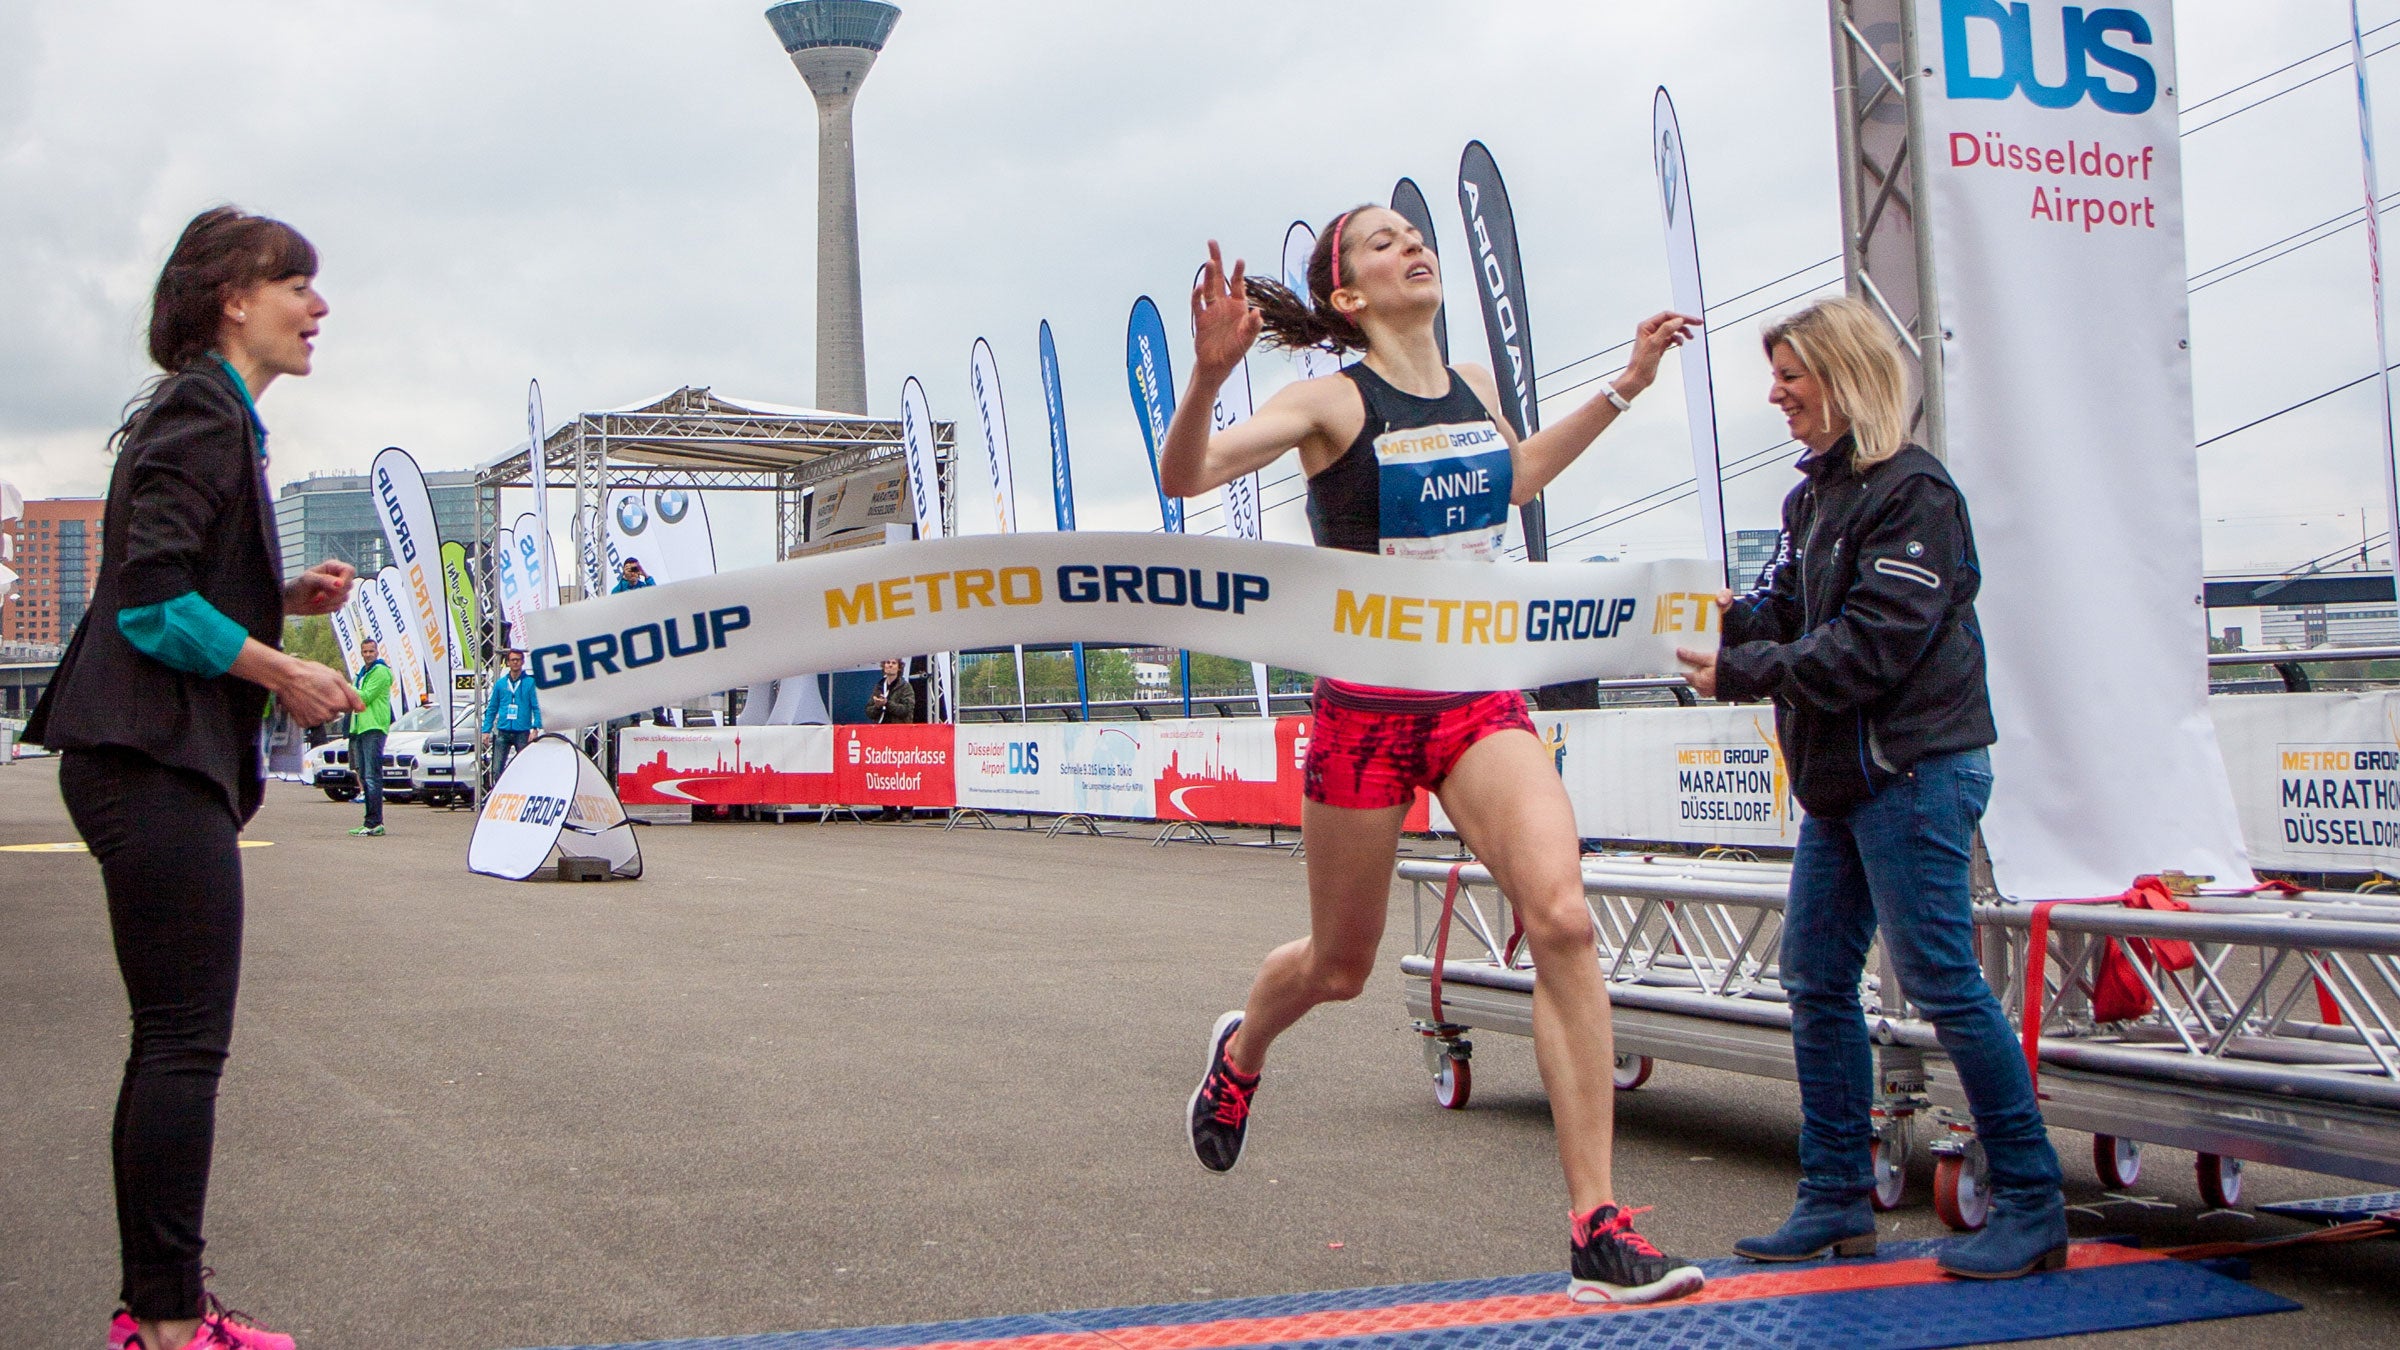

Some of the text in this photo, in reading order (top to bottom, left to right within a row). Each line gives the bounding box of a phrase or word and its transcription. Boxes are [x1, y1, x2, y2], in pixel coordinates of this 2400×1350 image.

[1940, 0, 2157, 115] DUS
[1949, 132, 2153, 181] Düsseldorf
[2030, 186, 2155, 233] Airport
[1381, 434, 1449, 456] METRO
[1420, 469, 1490, 503] ANNIE
[1446, 506, 1466, 527] F1
[531, 565, 1722, 690] GROUP METRO GROUP METRO GROUP MET
[864, 746, 946, 769] Stadtsparkasse
[968, 743, 1005, 756] Düsseldorf
[1009, 742, 1039, 775] DUS
[1678, 749, 1769, 765] METRO GROUP
[2282, 751, 2351, 771] METRO
[981, 761, 1005, 777] Airport
[1060, 763, 1083, 776] Schnelle
[1117, 764, 1132, 777] Tokio
[867, 771, 922, 791] Düsseldorf
[1680, 770, 1771, 793] MARATHON
[485, 793, 527, 822] METRO
[519, 795, 567, 827] GROUP
[1681, 795, 1771, 821] DÜSSELDORF
[2284, 812, 2400, 848] DÜSSELDOR
